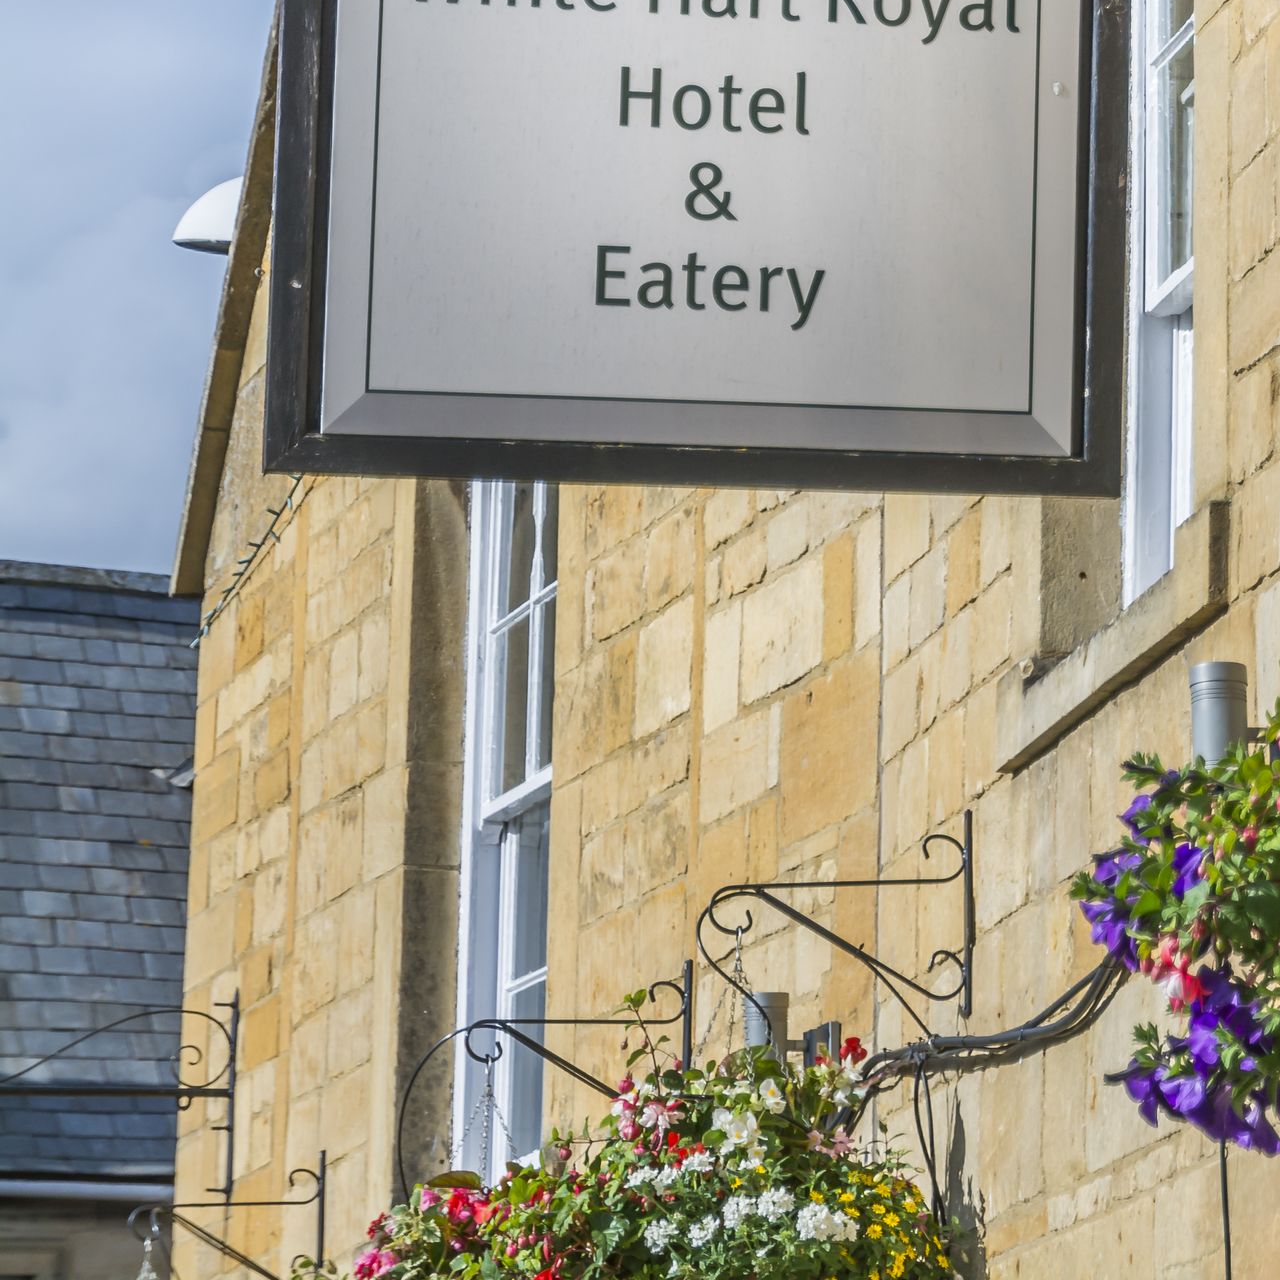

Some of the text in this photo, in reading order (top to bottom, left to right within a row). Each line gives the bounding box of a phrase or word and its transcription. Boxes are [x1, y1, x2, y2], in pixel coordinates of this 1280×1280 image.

[618, 65, 811, 136] Hotel
[684, 161, 738, 222] &
[593, 244, 827, 332] Eatery
